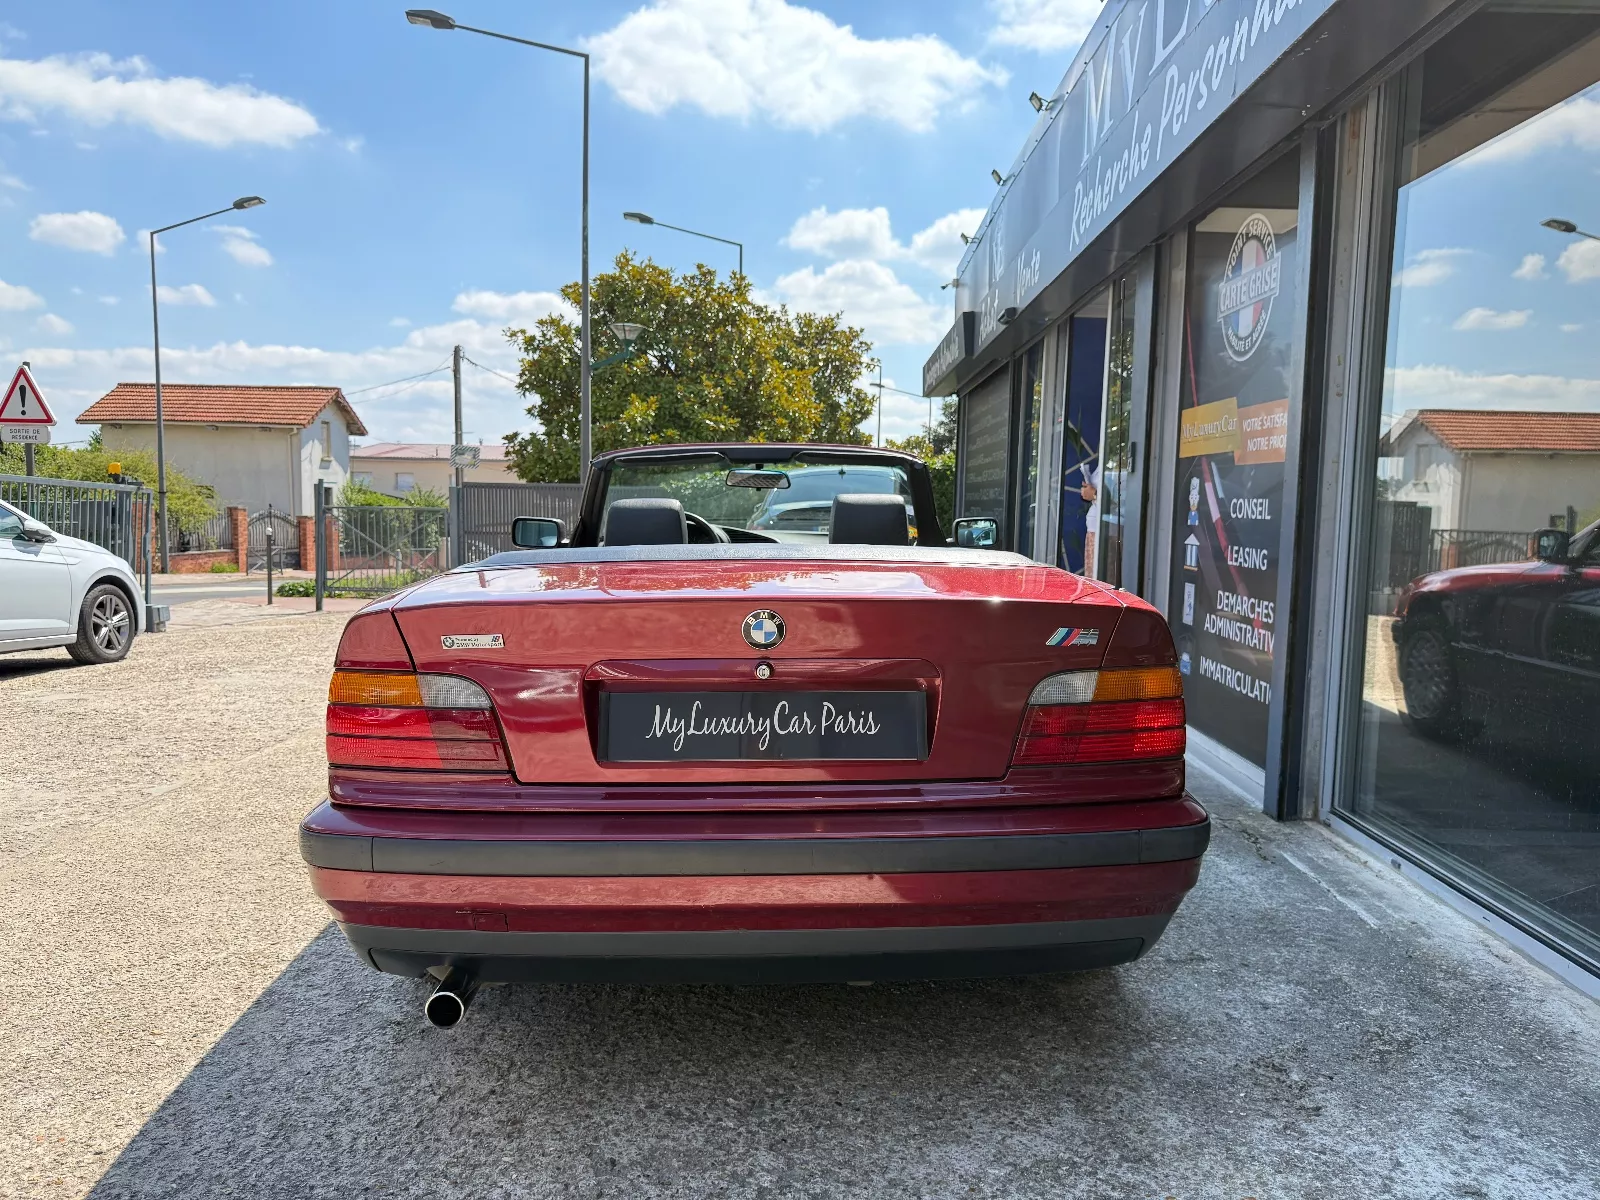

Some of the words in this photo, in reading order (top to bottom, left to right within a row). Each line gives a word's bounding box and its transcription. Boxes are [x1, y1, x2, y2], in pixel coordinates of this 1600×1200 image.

[1077, 0, 1218, 168] MyL
[1016, 248, 1040, 305] Vente
[1070, 110, 1152, 252] Recherche
[1156, 0, 1303, 162] Personn
[1228, 227, 1247, 279] POINT
[1249, 219, 1273, 261] SERVICE
[1220, 277, 1248, 312] CARTE
[1249, 262, 1278, 298] GRISE
[1182, 414, 1238, 442] MyLuxuryCar
[1243, 416, 1262, 432] VOTRE
[1247, 436, 1269, 452] NOTRE
[1230, 498, 1271, 520] CONSEIL
[1227, 545, 1268, 571] LEASING
[747, 612, 781, 625] BMW
[1216, 590, 1275, 624] DEMARCHES
[1203, 613, 1275, 653] ADMINISTRATIV
[1200, 655, 1271, 705] IMMATRICULATI
[645, 700, 817, 752] MyLuxuryCar
[821, 701, 881, 736] Paris
